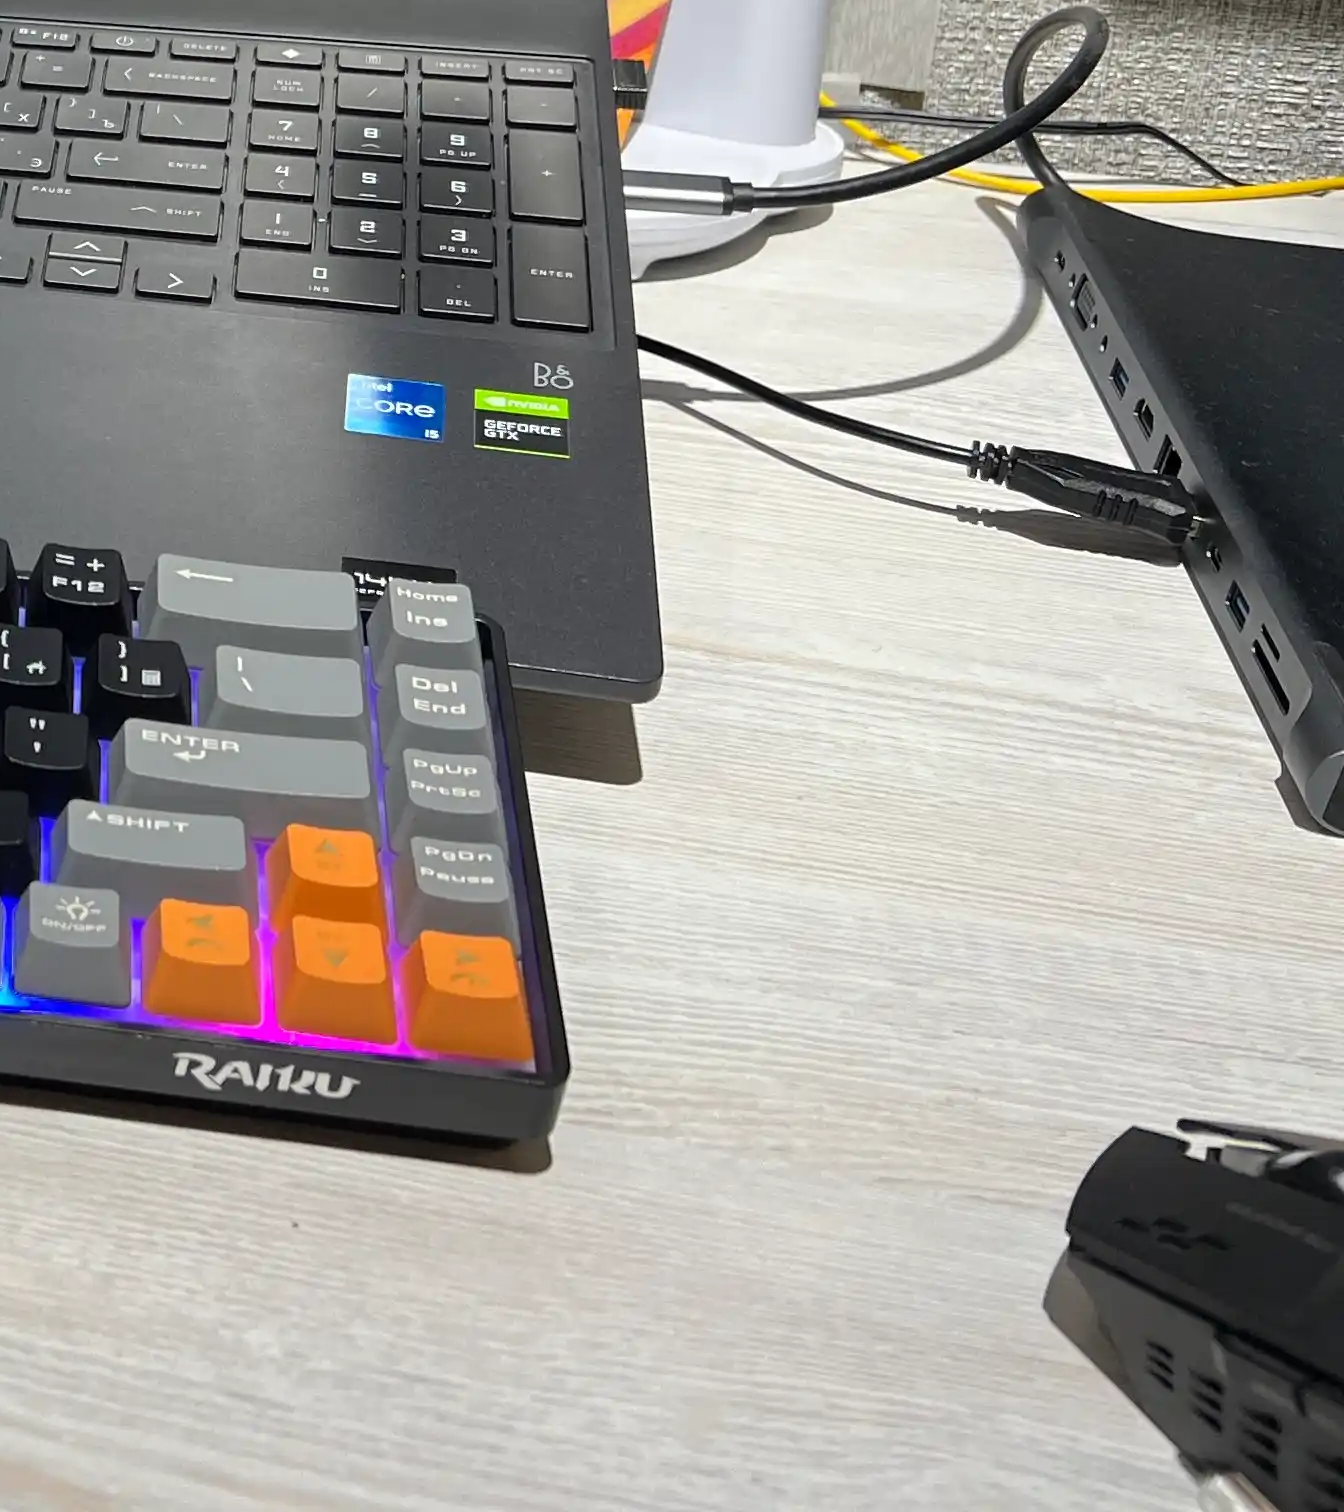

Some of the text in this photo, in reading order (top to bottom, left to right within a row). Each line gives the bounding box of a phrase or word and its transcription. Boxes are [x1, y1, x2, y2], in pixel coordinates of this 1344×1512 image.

[483, 419, 563, 437] GEFORCE
[483, 429, 520, 441] GTX
[396, 586, 460, 605] Home
[407, 609, 449, 629] Ins
[411, 676, 459, 695] Del
[412, 699, 467, 717] End
[141, 730, 241, 754] ENTER
[412, 757, 478, 778] PgUp
[106, 814, 190, 834] SHIFT
[423, 845, 493, 865] PgDn
[419, 866, 495, 886] Pause
[172, 1051, 362, 1100] RAIKU
